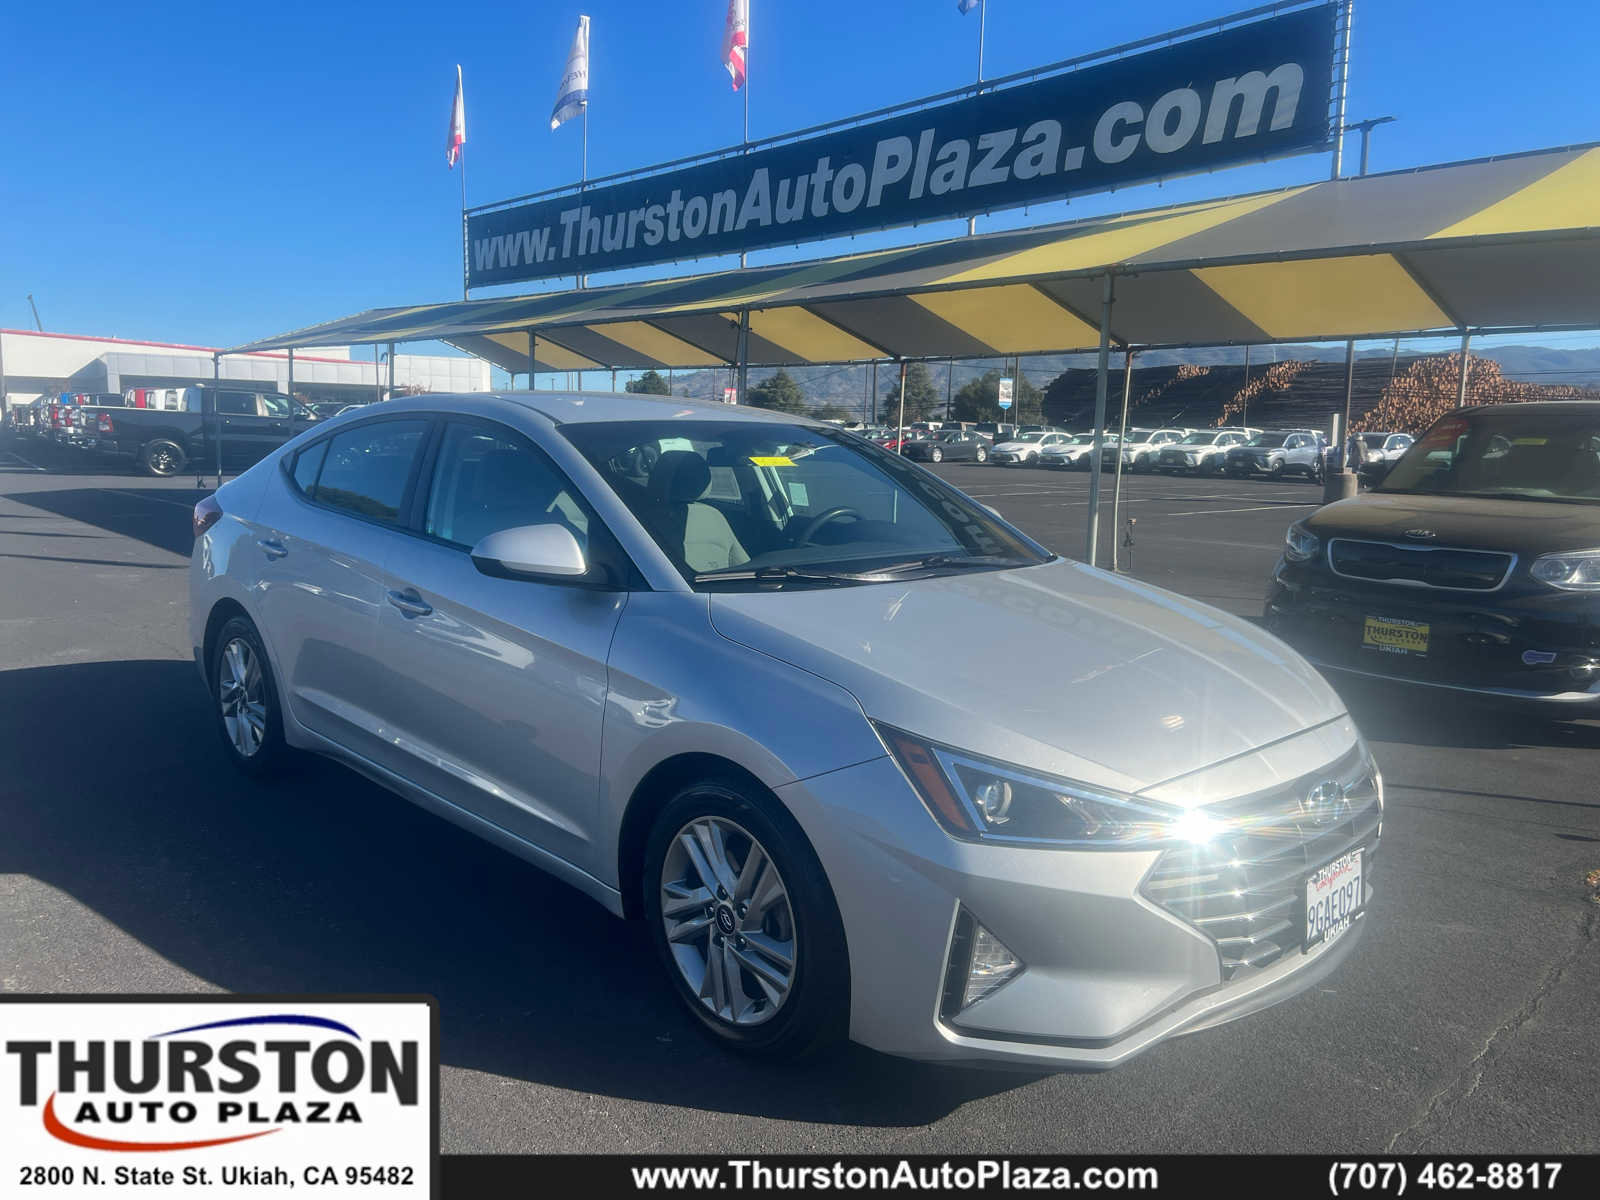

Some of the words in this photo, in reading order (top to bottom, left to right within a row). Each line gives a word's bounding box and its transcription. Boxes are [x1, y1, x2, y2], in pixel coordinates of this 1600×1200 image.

[473, 63, 1304, 272] www.ThurstonAutoPlaza.com
[1366, 626, 1429, 643] THURSTON
[1308, 875, 1361, 943] 9GAE097
